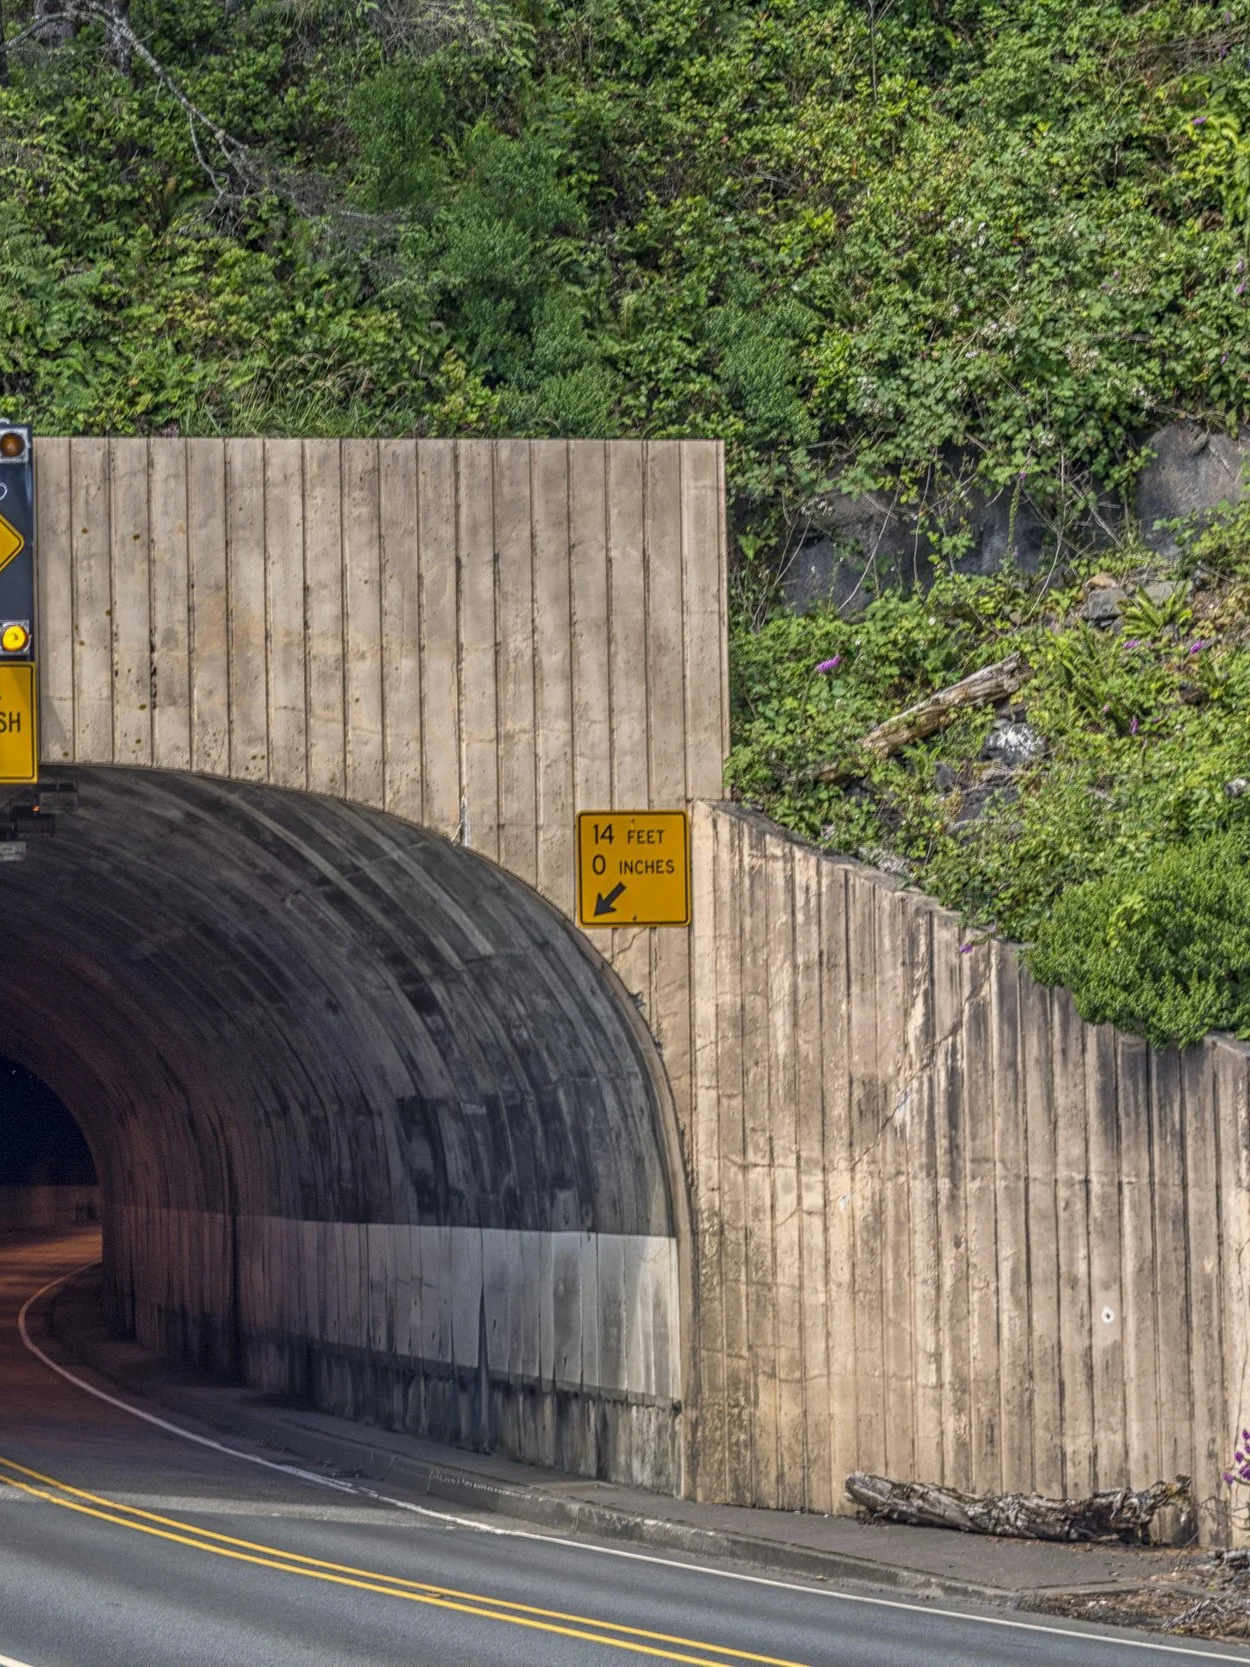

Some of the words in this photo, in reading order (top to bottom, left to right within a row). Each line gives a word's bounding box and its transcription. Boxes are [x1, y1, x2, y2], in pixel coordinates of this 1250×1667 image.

[593, 823, 614, 845] 14
[627, 829, 665, 845] FEET
[592, 854, 606, 875] 0
[619, 859, 675, 875] INCHES
